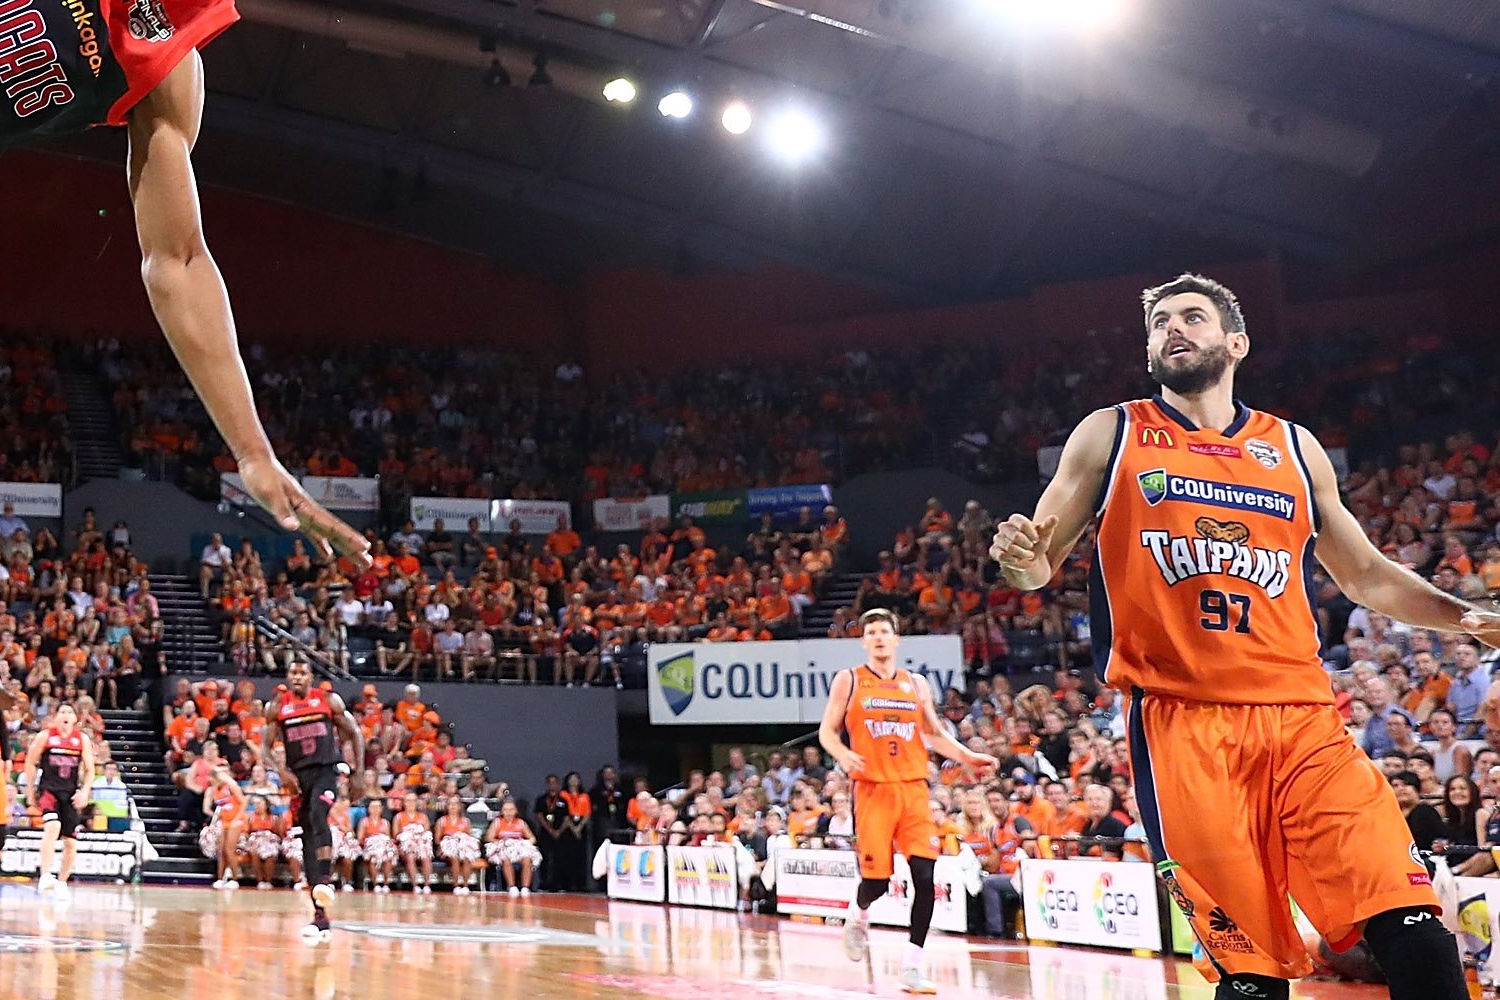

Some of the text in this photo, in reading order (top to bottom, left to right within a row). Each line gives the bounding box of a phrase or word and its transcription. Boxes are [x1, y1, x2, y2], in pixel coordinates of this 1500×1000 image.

[1170, 476, 1294, 519] CQUniversity
[1140, 530, 1292, 599] TAIPANS
[1200, 590, 1252, 634] 97
[888, 741, 898, 757] 3
[1044, 889, 1079, 912] CEQ
[1103, 892, 1138, 916] CEQ
[1206, 938, 1254, 951] Regional
[1208, 931, 1246, 943] Cairns
